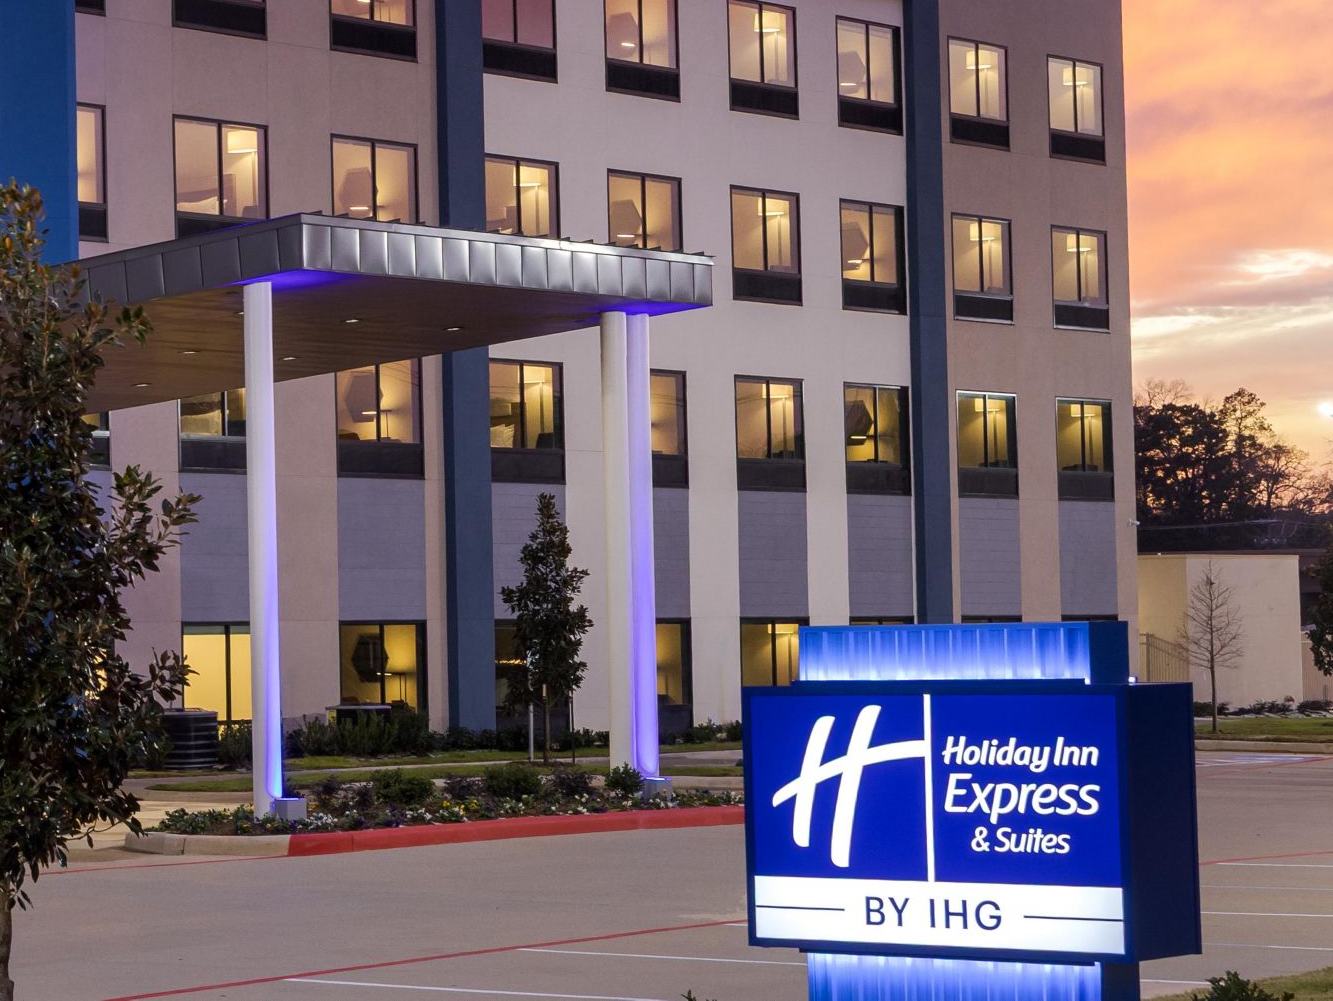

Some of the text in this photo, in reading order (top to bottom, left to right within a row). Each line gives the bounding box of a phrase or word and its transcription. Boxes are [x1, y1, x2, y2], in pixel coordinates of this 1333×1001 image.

[942, 736, 1098, 773] Holiday Inn
[944, 773, 1100, 824] Express
[971, 827, 1070, 854] & Suites
[865, 896, 1002, 930] BY IHG
